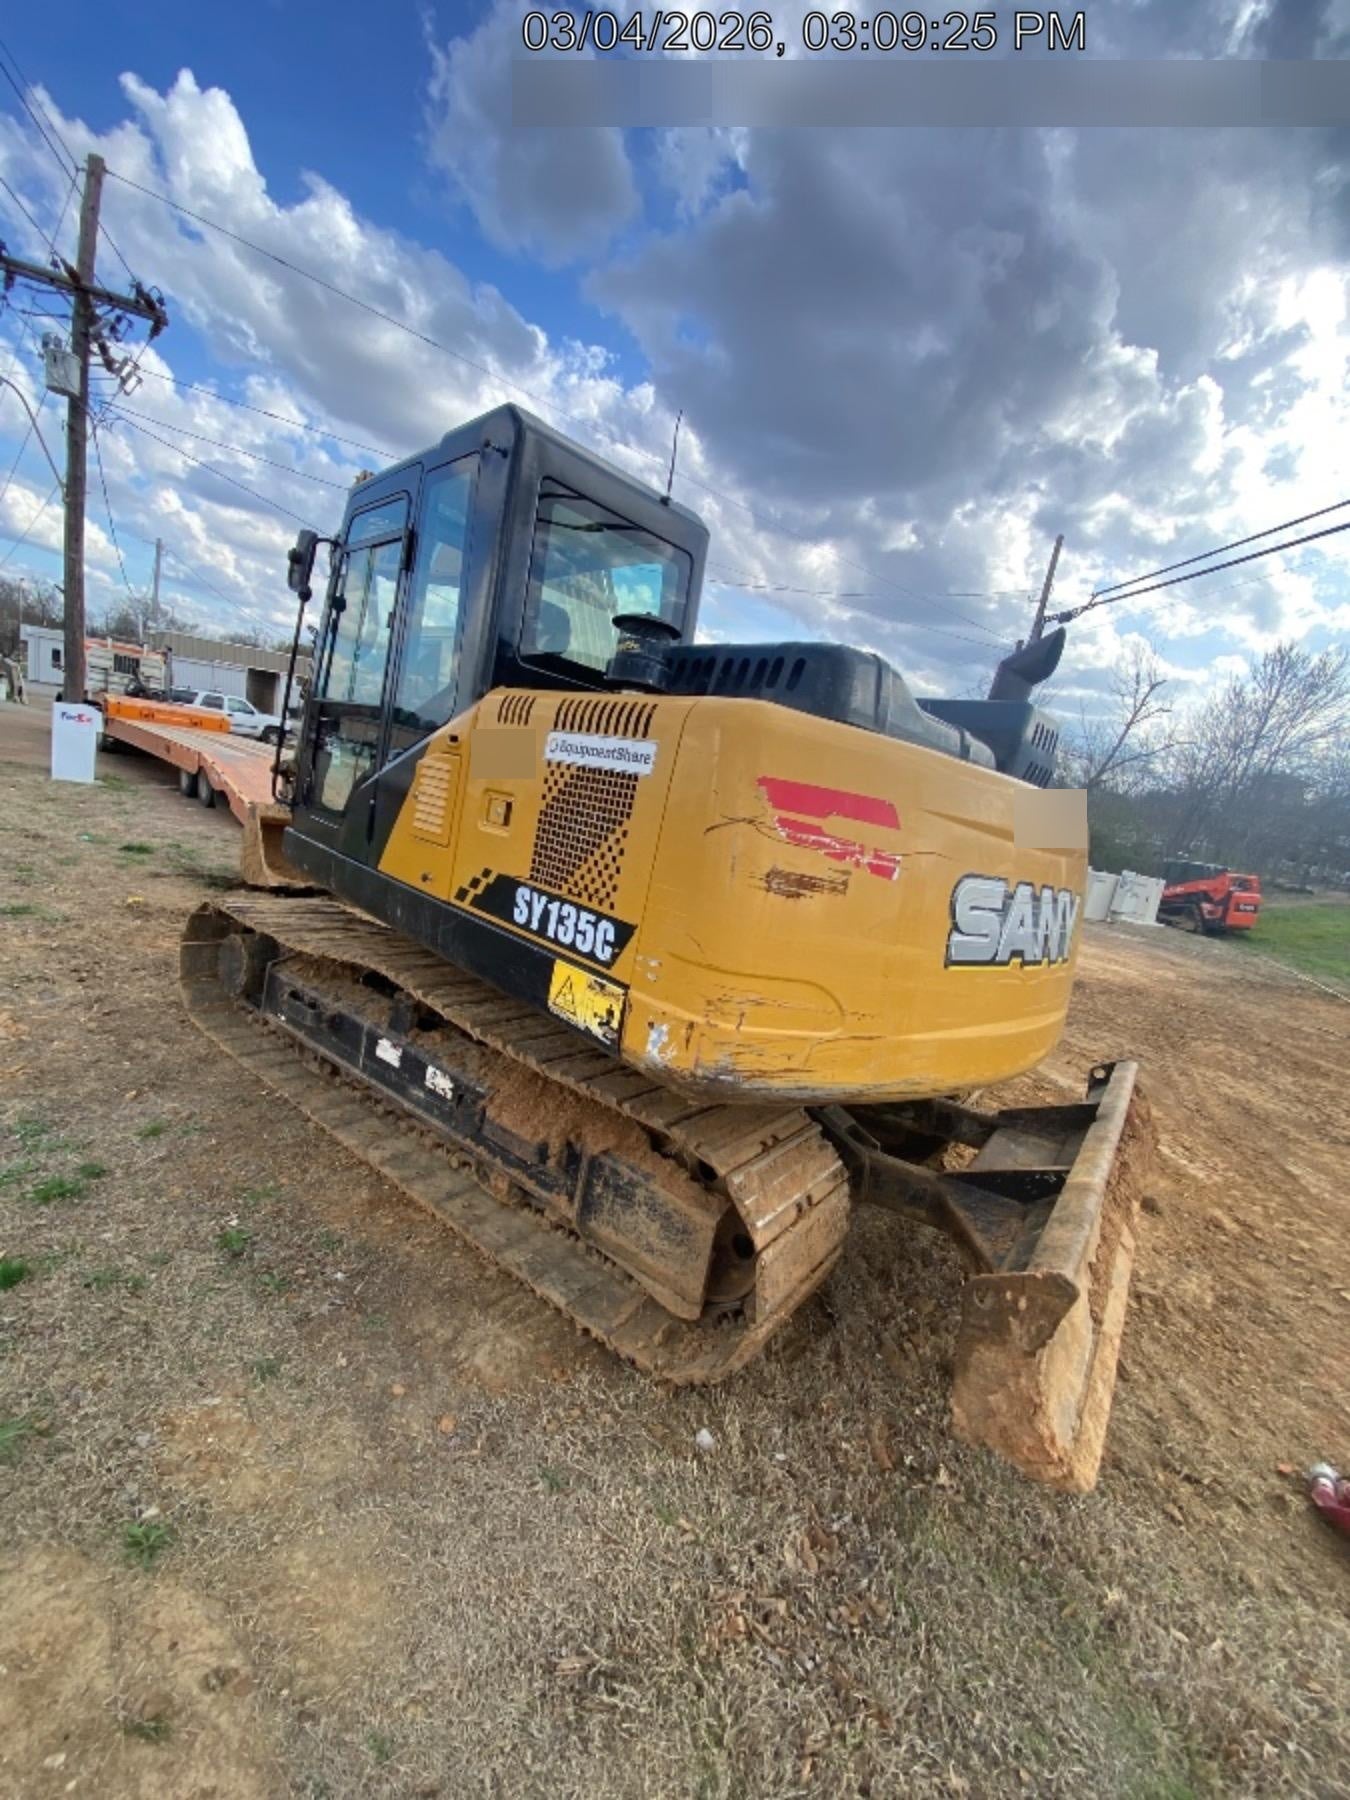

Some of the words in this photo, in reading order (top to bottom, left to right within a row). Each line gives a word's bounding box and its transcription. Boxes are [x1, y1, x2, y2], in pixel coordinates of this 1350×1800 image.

[559, 740, 652, 765] EquipmentShare
[513, 886, 615, 961] SY135C
[944, 873, 1081, 969] SANY
